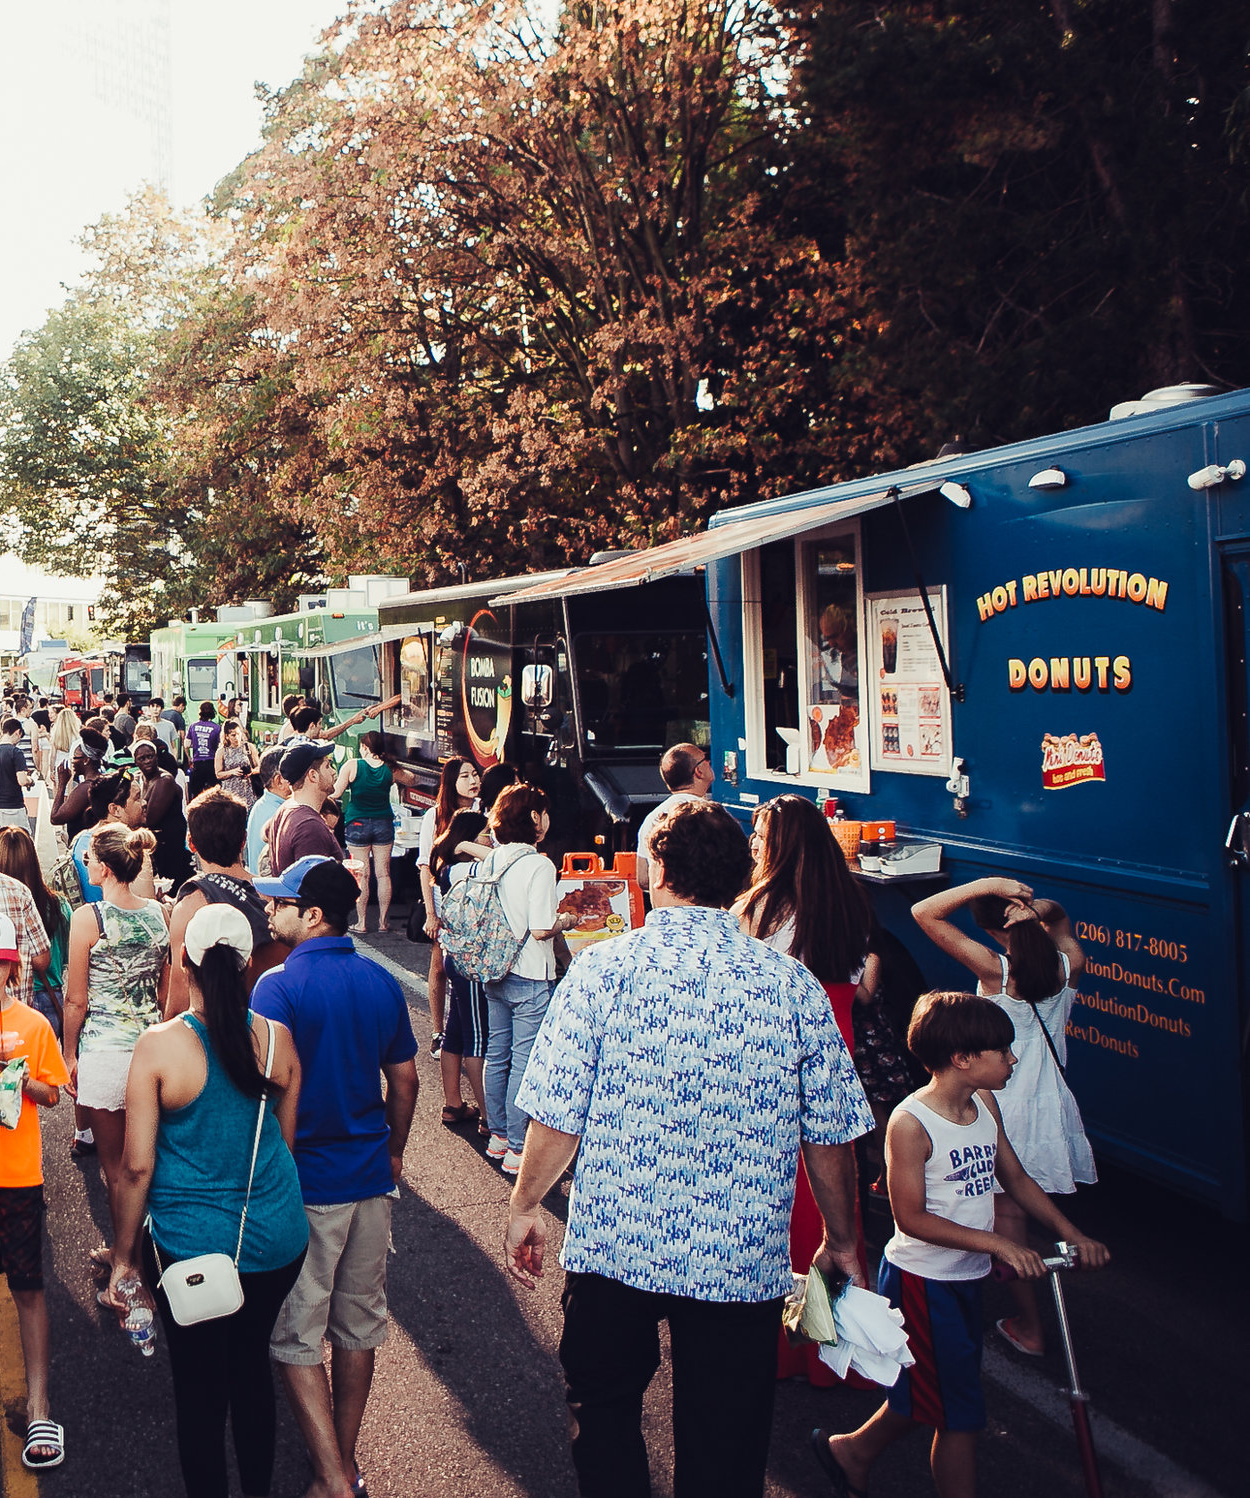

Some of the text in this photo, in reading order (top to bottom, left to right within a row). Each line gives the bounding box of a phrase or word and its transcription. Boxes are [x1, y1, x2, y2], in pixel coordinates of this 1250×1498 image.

[976, 568, 1169, 621] HOT REVOLUTION
[470, 657, 495, 678] BOMBA
[1008, 655, 1132, 690] DONUTS
[470, 686, 495, 708] FUSION
[1075, 920, 1188, 963] (206) 817-8005
[1085, 956, 1205, 1004] tionDonuts.Com
[1074, 991, 1191, 1037] evolutionDonuts
[970, 1160, 994, 1178] CUD
